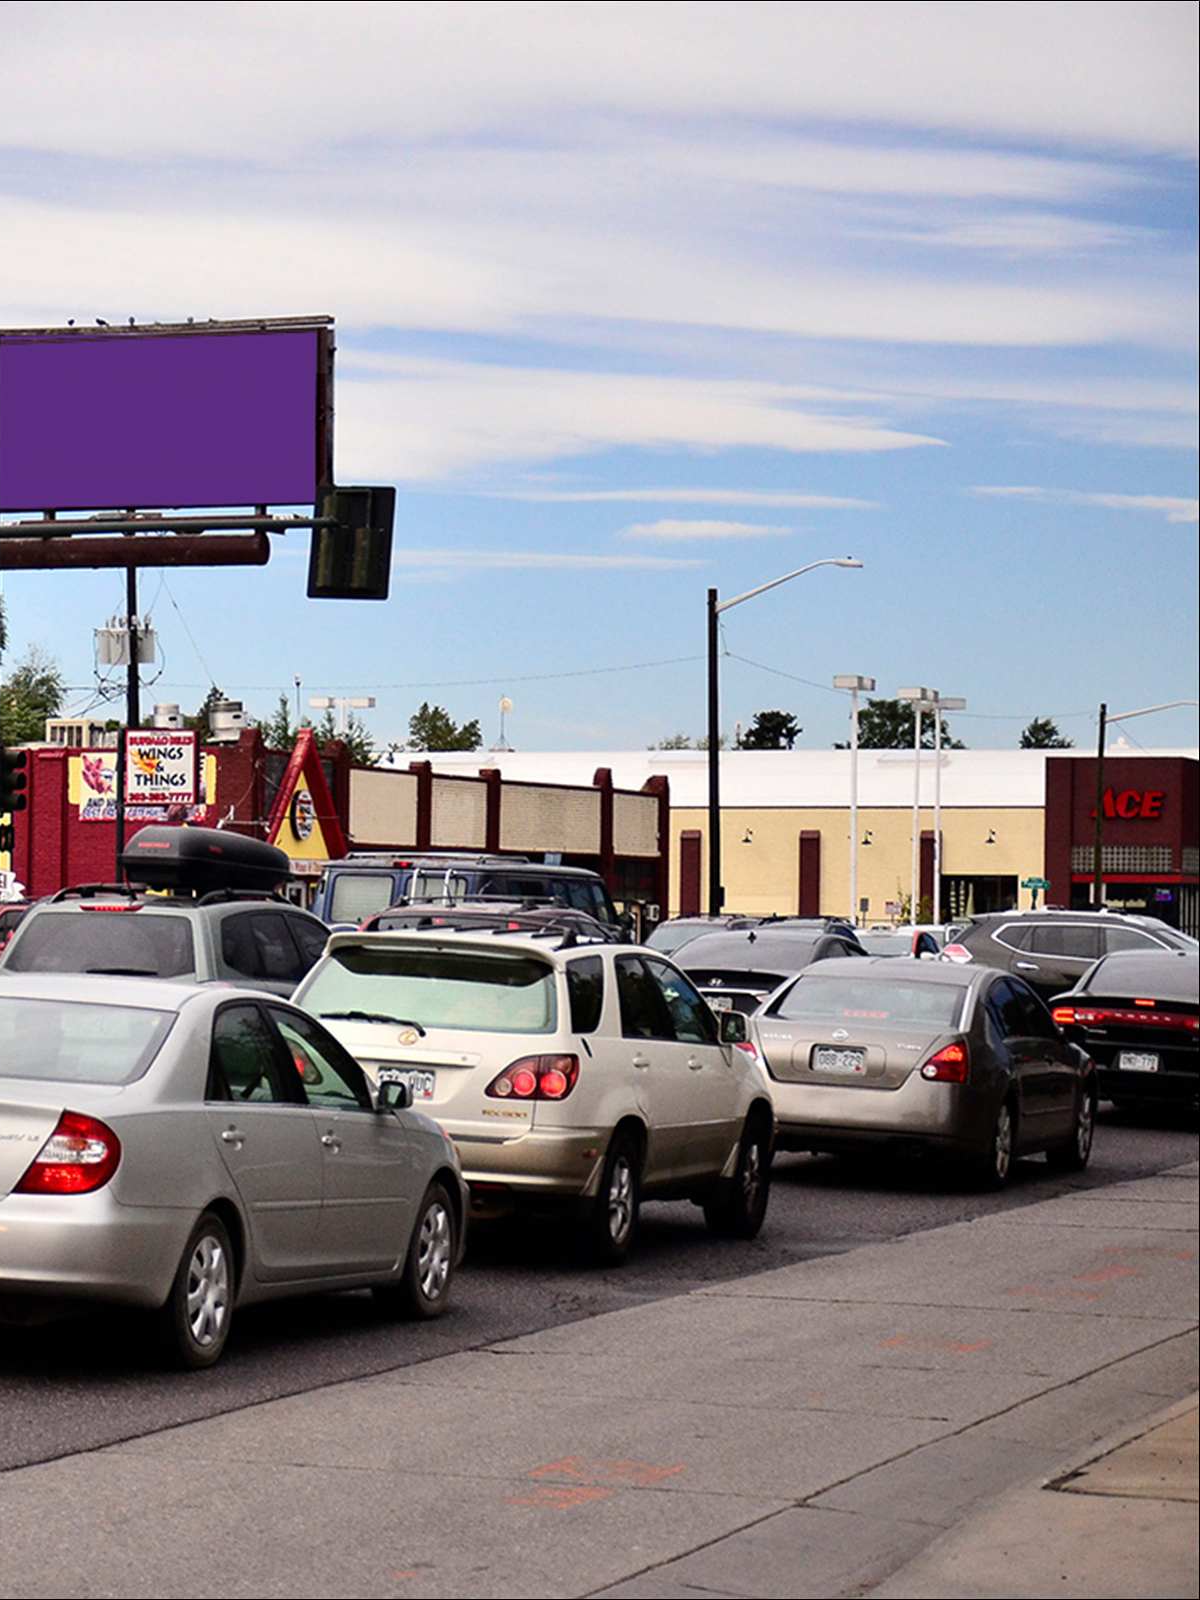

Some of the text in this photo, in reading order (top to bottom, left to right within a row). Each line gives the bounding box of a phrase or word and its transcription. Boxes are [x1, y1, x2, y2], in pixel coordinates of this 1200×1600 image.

[138, 747, 184, 760] WINGS
[155, 760, 164, 772] &
[134, 774, 186, 786] THINGS
[1090, 786, 1164, 818] ACE
